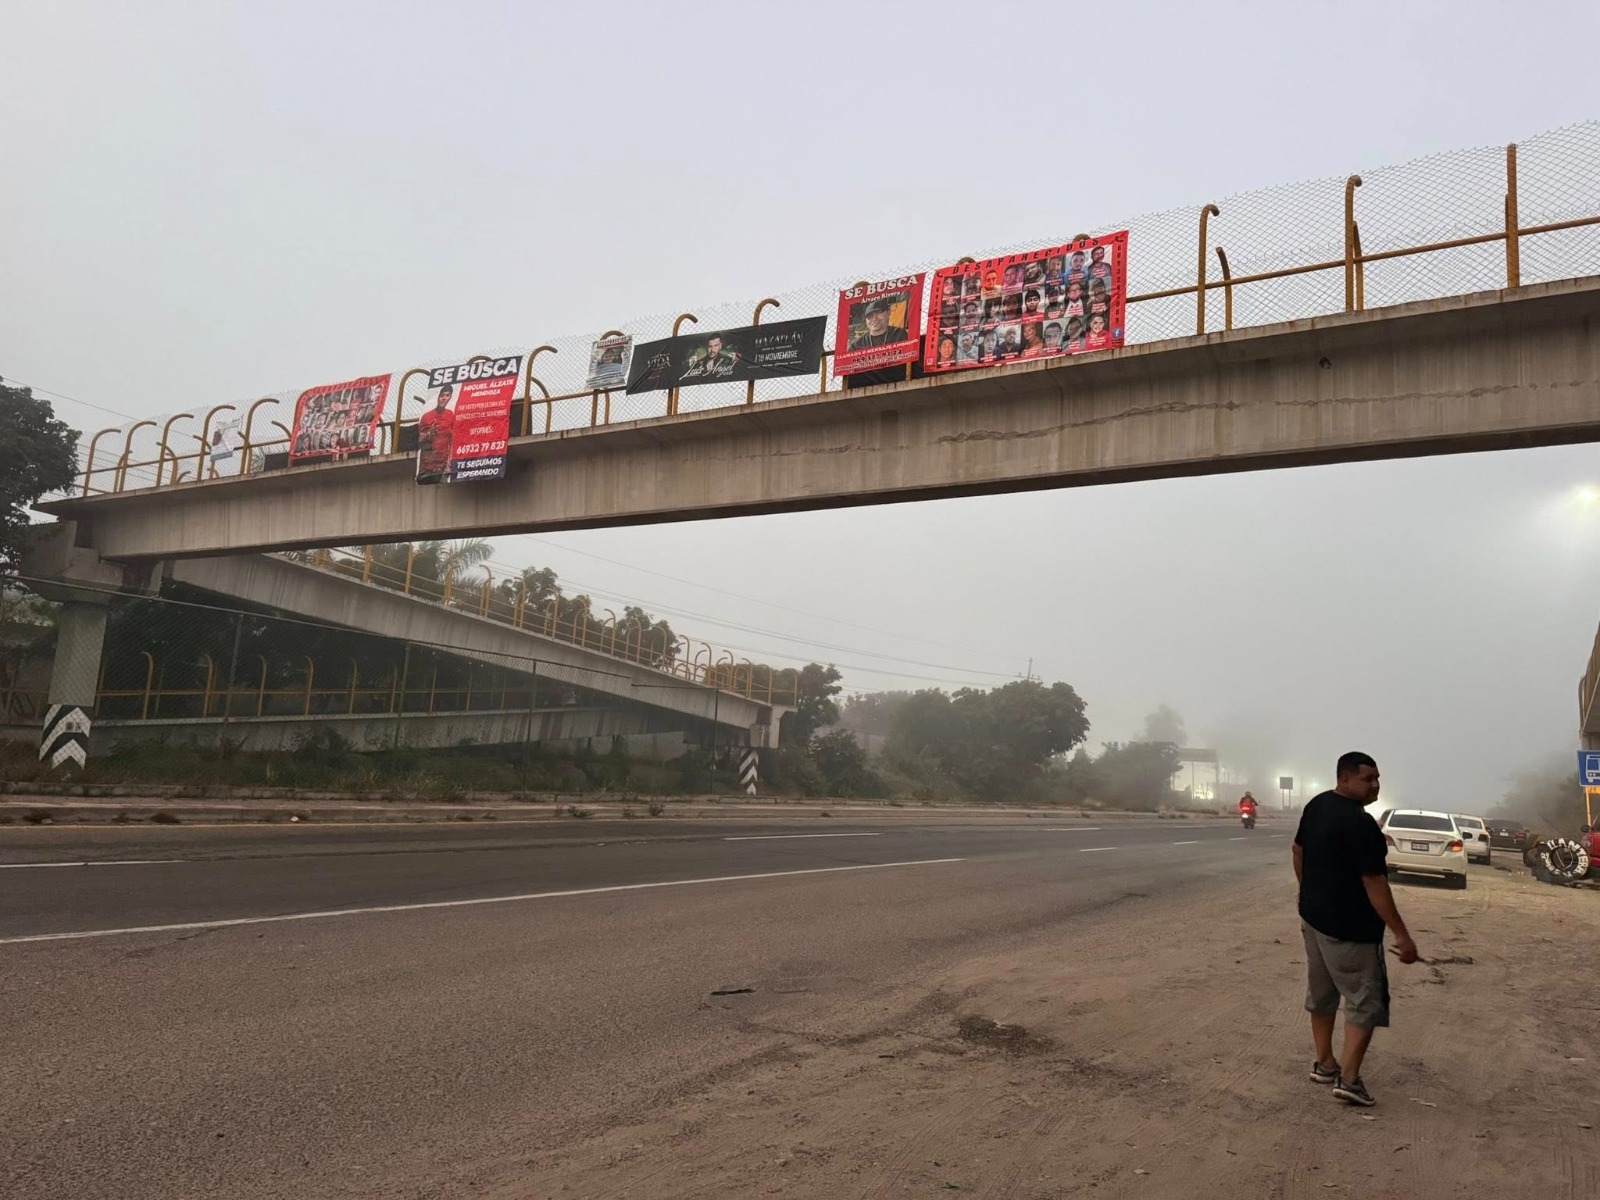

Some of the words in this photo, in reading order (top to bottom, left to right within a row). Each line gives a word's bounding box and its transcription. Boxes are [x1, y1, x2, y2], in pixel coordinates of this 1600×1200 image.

[844, 286, 864, 300] SE
[866, 275, 918, 295] BUSCA
[432, 368, 455, 385] SE
[456, 358, 517, 381] BUSCA
[463, 383, 488, 392] MIGUEL
[457, 461, 466, 469] TE
[466, 457, 502, 468] SEGUIMOS
